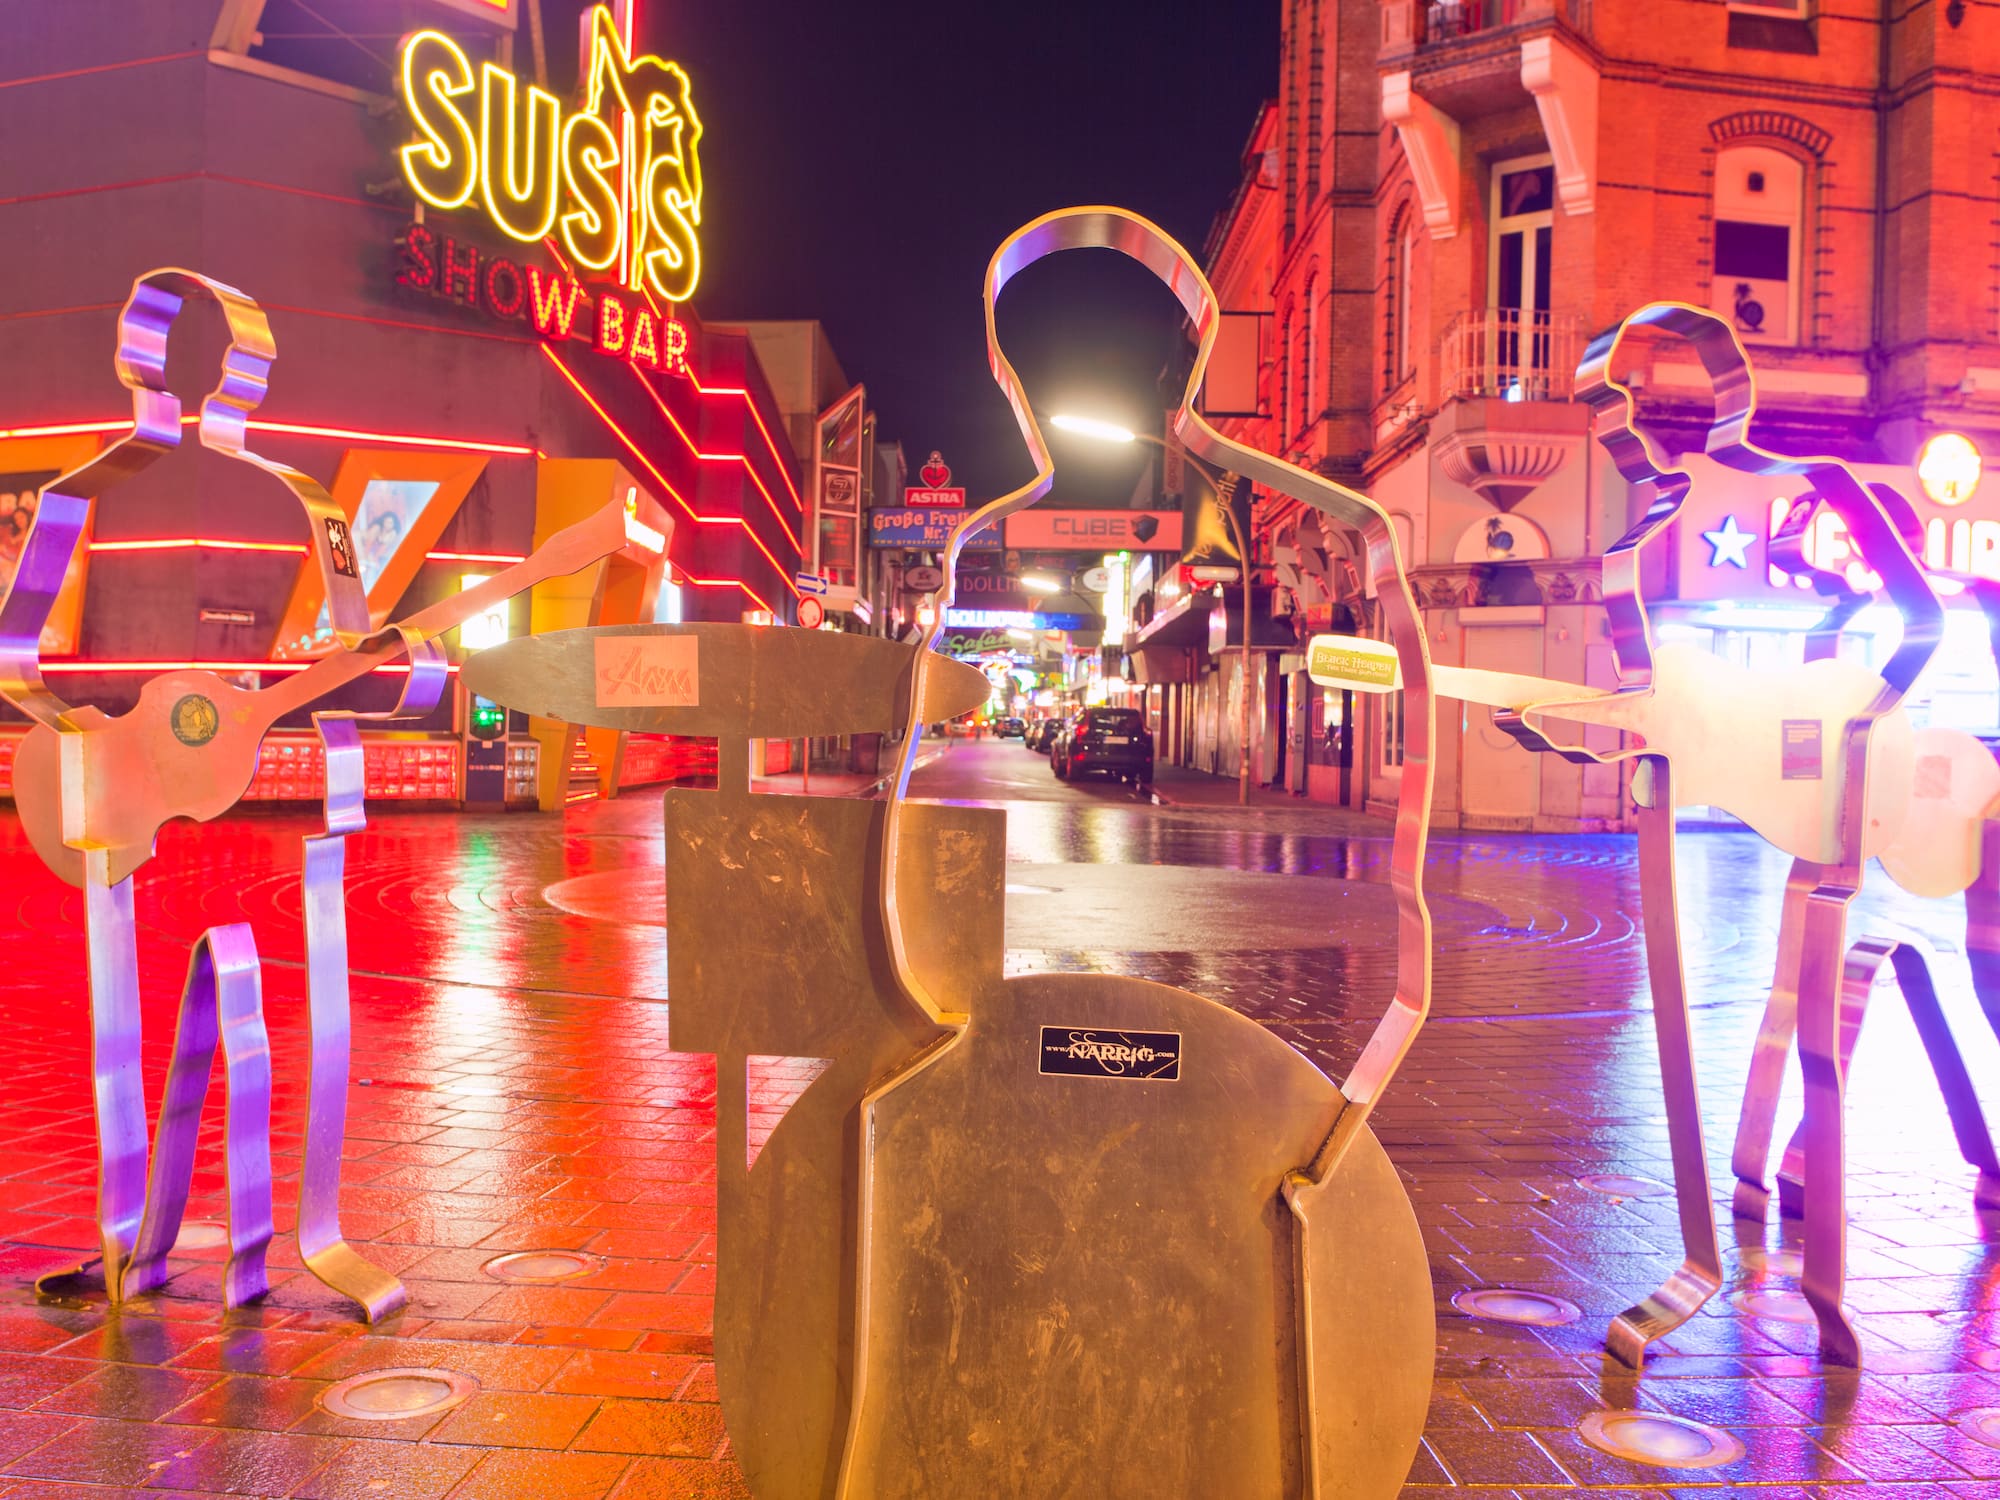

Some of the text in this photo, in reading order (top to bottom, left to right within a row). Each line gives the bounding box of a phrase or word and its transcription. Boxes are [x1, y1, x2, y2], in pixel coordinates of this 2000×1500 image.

[397, 222, 690, 378] SHOW BAR
[909, 490, 962, 504] ASTRA
[872, 511, 925, 532] Große
[1052, 517, 1127, 536] CUBE
